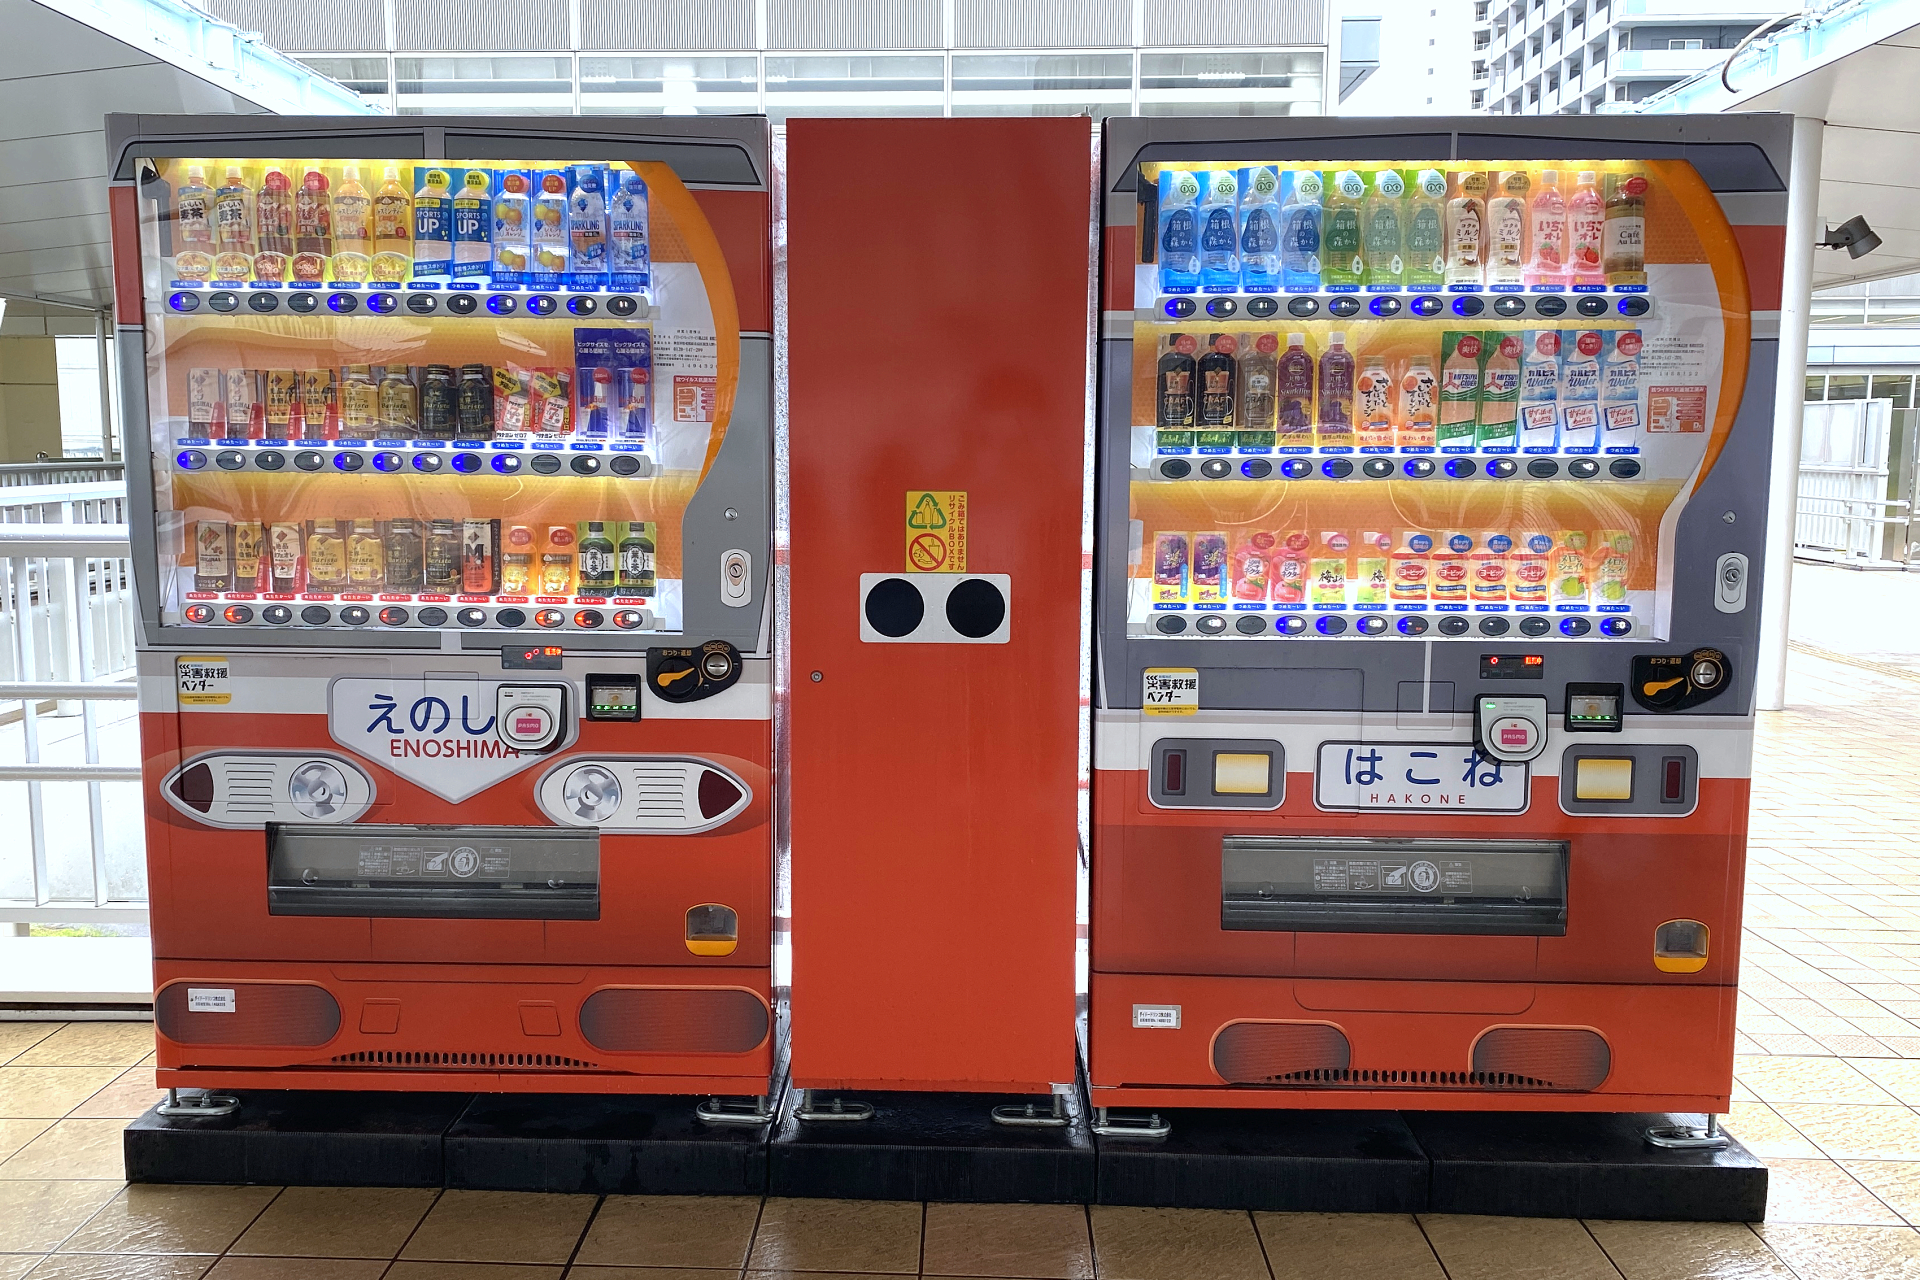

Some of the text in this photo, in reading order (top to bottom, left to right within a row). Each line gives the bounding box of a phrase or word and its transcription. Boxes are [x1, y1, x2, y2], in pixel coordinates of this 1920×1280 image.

[218, 202, 240, 210] おいしい
[180, 208, 204, 221] 麦茶
[218, 208, 242, 222] 麦茶
[418, 218, 440, 234] UP
[458, 220, 479, 234] UP
[571, 220, 600, 231] SPARKLING
[614, 220, 644, 232] SPARKLING
[1172, 220, 1192, 230] 箱根
[1210, 220, 1230, 230] 箱根
[1249, 220, 1270, 230] 箱根
[1292, 220, 1314, 230] 箱根
[1336, 220, 1356, 230] 箱根
[1375, 220, 1396, 230] 箱根
[1417, 220, 1438, 230] 箱根
[1498, 228, 1520, 236] ミルク
[1620, 230, 1640, 239] Café
[1170, 237, 1193, 247] 森から
[1209, 236, 1232, 246] 森から
[1248, 237, 1272, 248] 森から
[1290, 236, 1314, 246] 森から
[1334, 236, 1357, 246] 森から
[1372, 236, 1396, 246] 森から
[1414, 236, 1438, 246] 森から
[1526, 376, 1556, 387] Water
[1568, 376, 1598, 387] Water
[1608, 376, 1638, 387] Water
[948, 494, 956, 571] リサイクルBOXです
[465, 544, 484, 563] M
[590, 550, 598, 574] 葉の茶
[630, 550, 640, 572] 葉の茶
[1605, 558, 1627, 566] メロン
[1602, 566, 1627, 574] シェイク
[181, 668, 228, 678] 災害救援
[182, 679, 214, 692] ベンダー
[1147, 678, 1196, 690] 災害救援
[1147, 690, 1182, 702] ベンダー
[366, 694, 496, 736] えのし
[390, 738, 520, 760] ENOSHIMA
[1344, 748, 1504, 788] はこね
[1370, 794, 1466, 805] HAKONE
